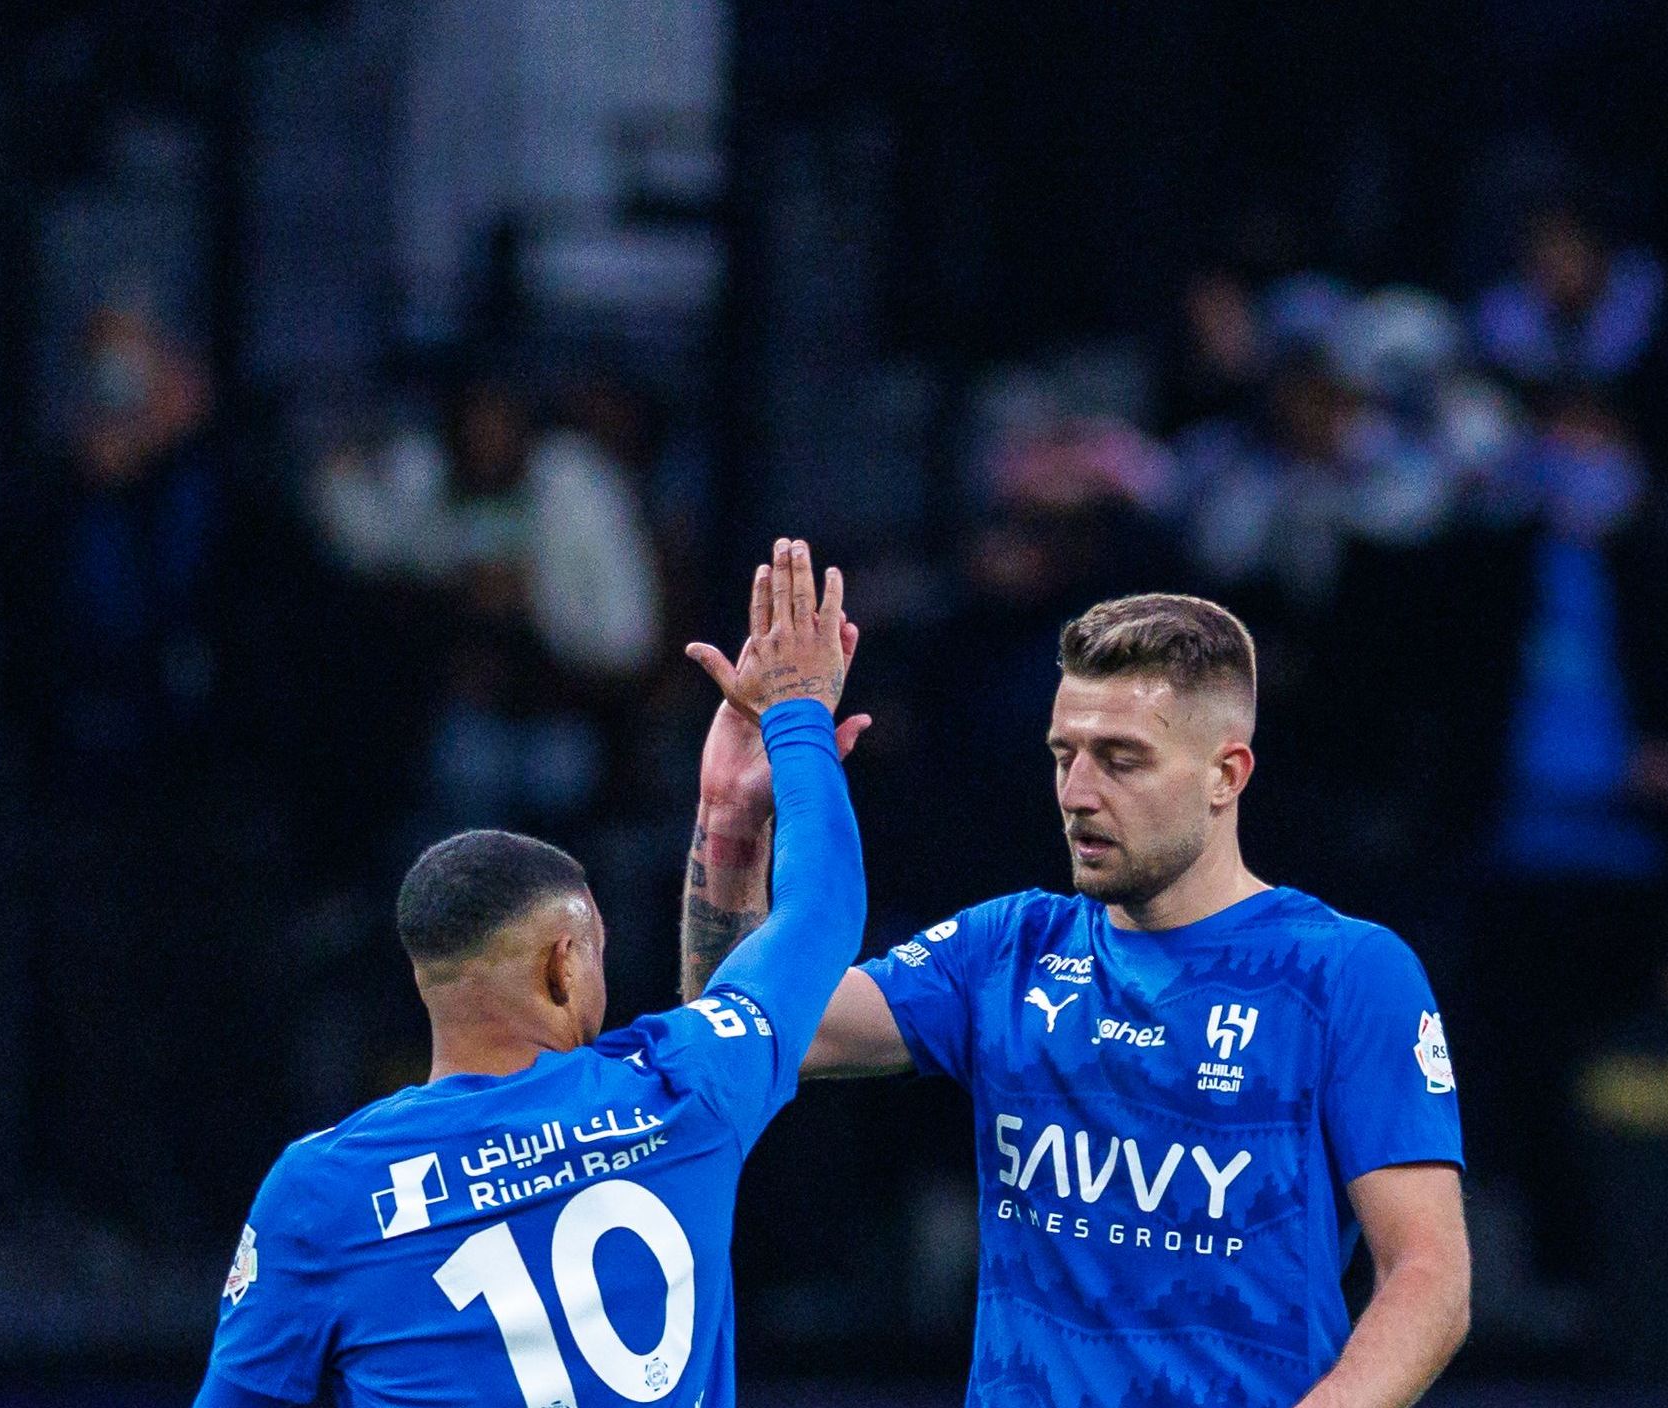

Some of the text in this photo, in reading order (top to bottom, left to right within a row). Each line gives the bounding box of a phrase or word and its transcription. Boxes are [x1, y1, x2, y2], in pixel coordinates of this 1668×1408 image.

[460, 1120, 566, 1177] الرياض
[581, 1131, 669, 1177] Bank
[995, 1113, 1252, 1219] SAVVY
[1109, 1223, 1244, 1257] GROUP
